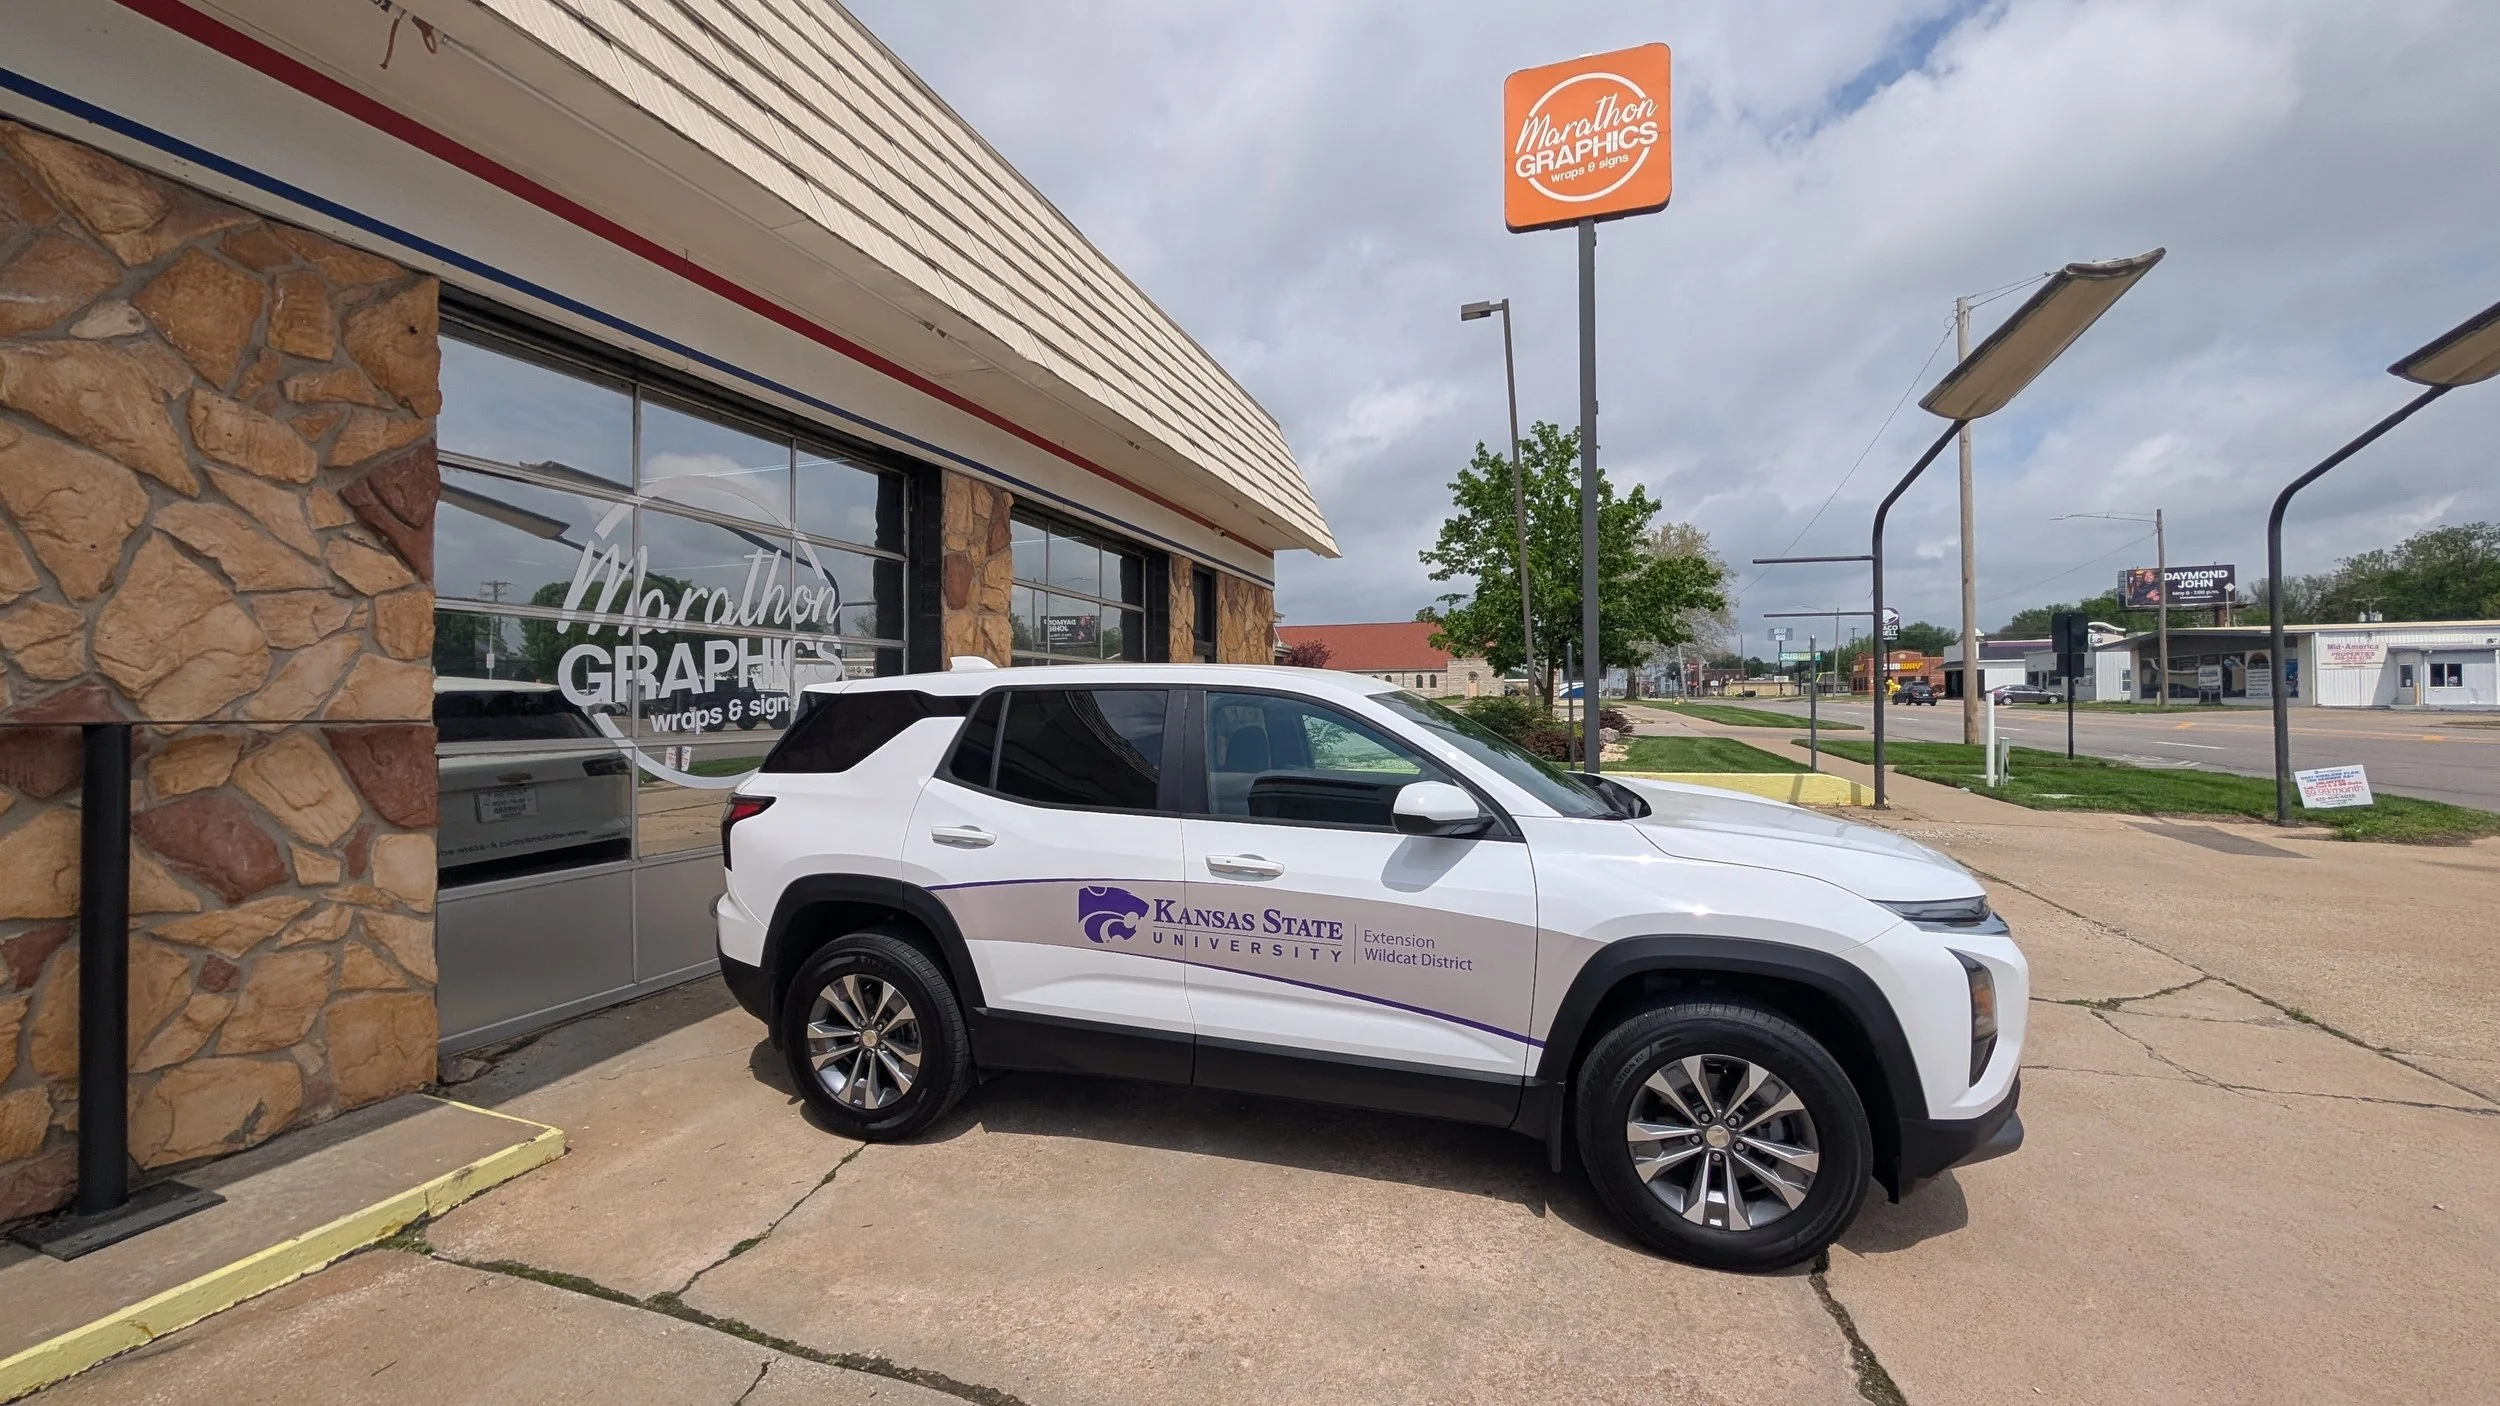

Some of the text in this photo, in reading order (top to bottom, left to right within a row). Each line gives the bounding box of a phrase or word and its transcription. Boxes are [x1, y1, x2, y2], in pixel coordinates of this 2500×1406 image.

[1515, 93, 1658, 154] Marathon
[1515, 121, 1658, 178] GRAPHICS
[1551, 154, 1629, 183] wraps & signs
[556, 540, 843, 637] Marathon
[2164, 570, 2228, 581] DAYMOND
[2177, 580, 2214, 589] JOHN
[1780, 652, 1811, 660] SUBWA
[558, 635, 842, 708] GRAPHICS
[650, 704, 723, 734] wraps
[728, 699, 743, 721] &
[2304, 785, 2364, 798] $9.99/month
[1153, 898, 1344, 941] KANSAS STATE
[1153, 931, 1343, 963] UNIVERSITY
[1364, 929, 1435, 949] Extension
[1364, 947, 1472, 971] Wildcat District
